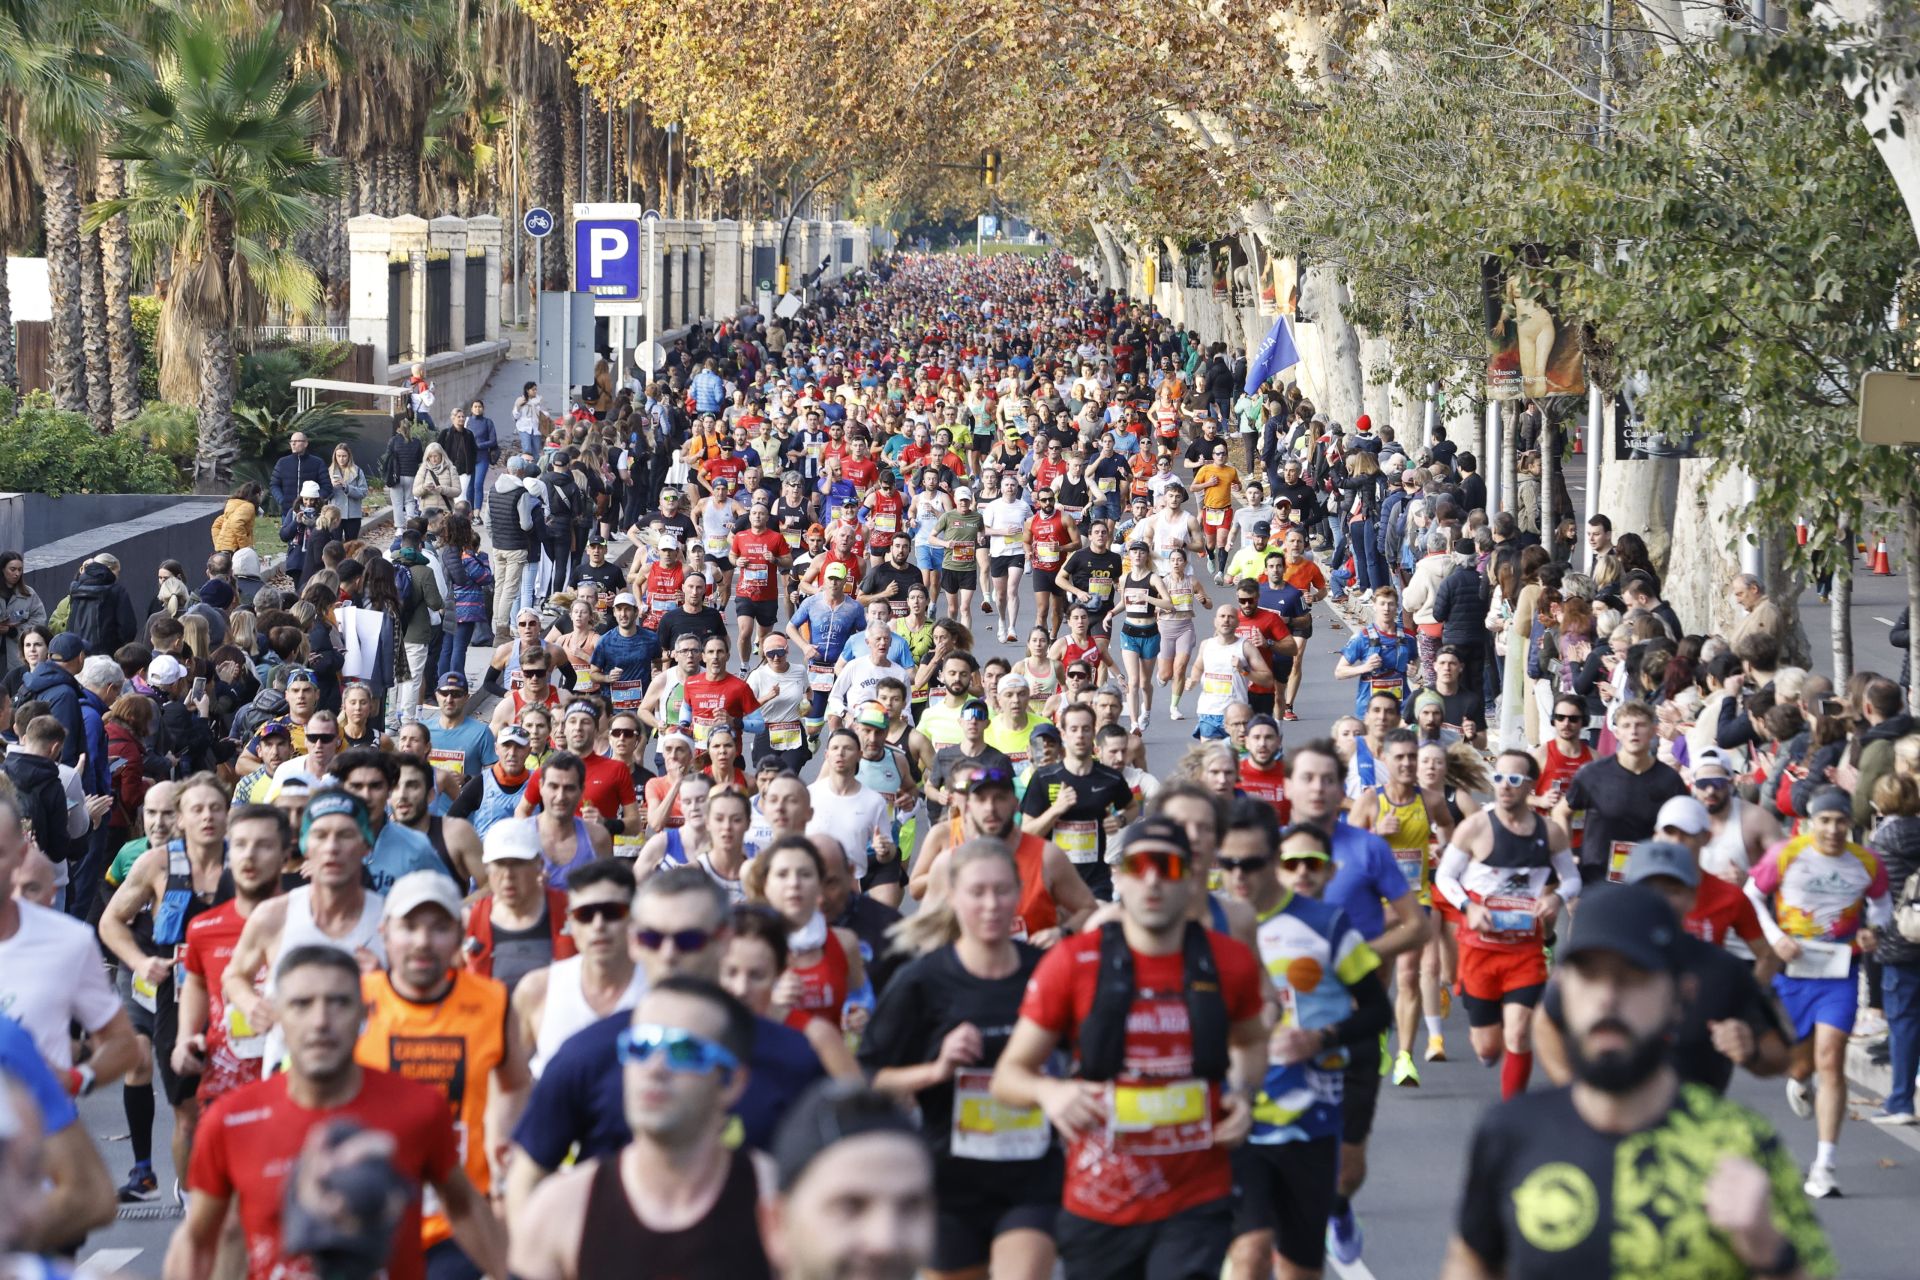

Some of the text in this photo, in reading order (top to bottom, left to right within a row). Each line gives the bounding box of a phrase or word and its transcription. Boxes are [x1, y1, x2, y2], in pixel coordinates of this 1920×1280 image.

[590, 228, 629, 278] P
[1493, 376, 1520, 384] Carmen
[1623, 418, 1645, 428] Mus
